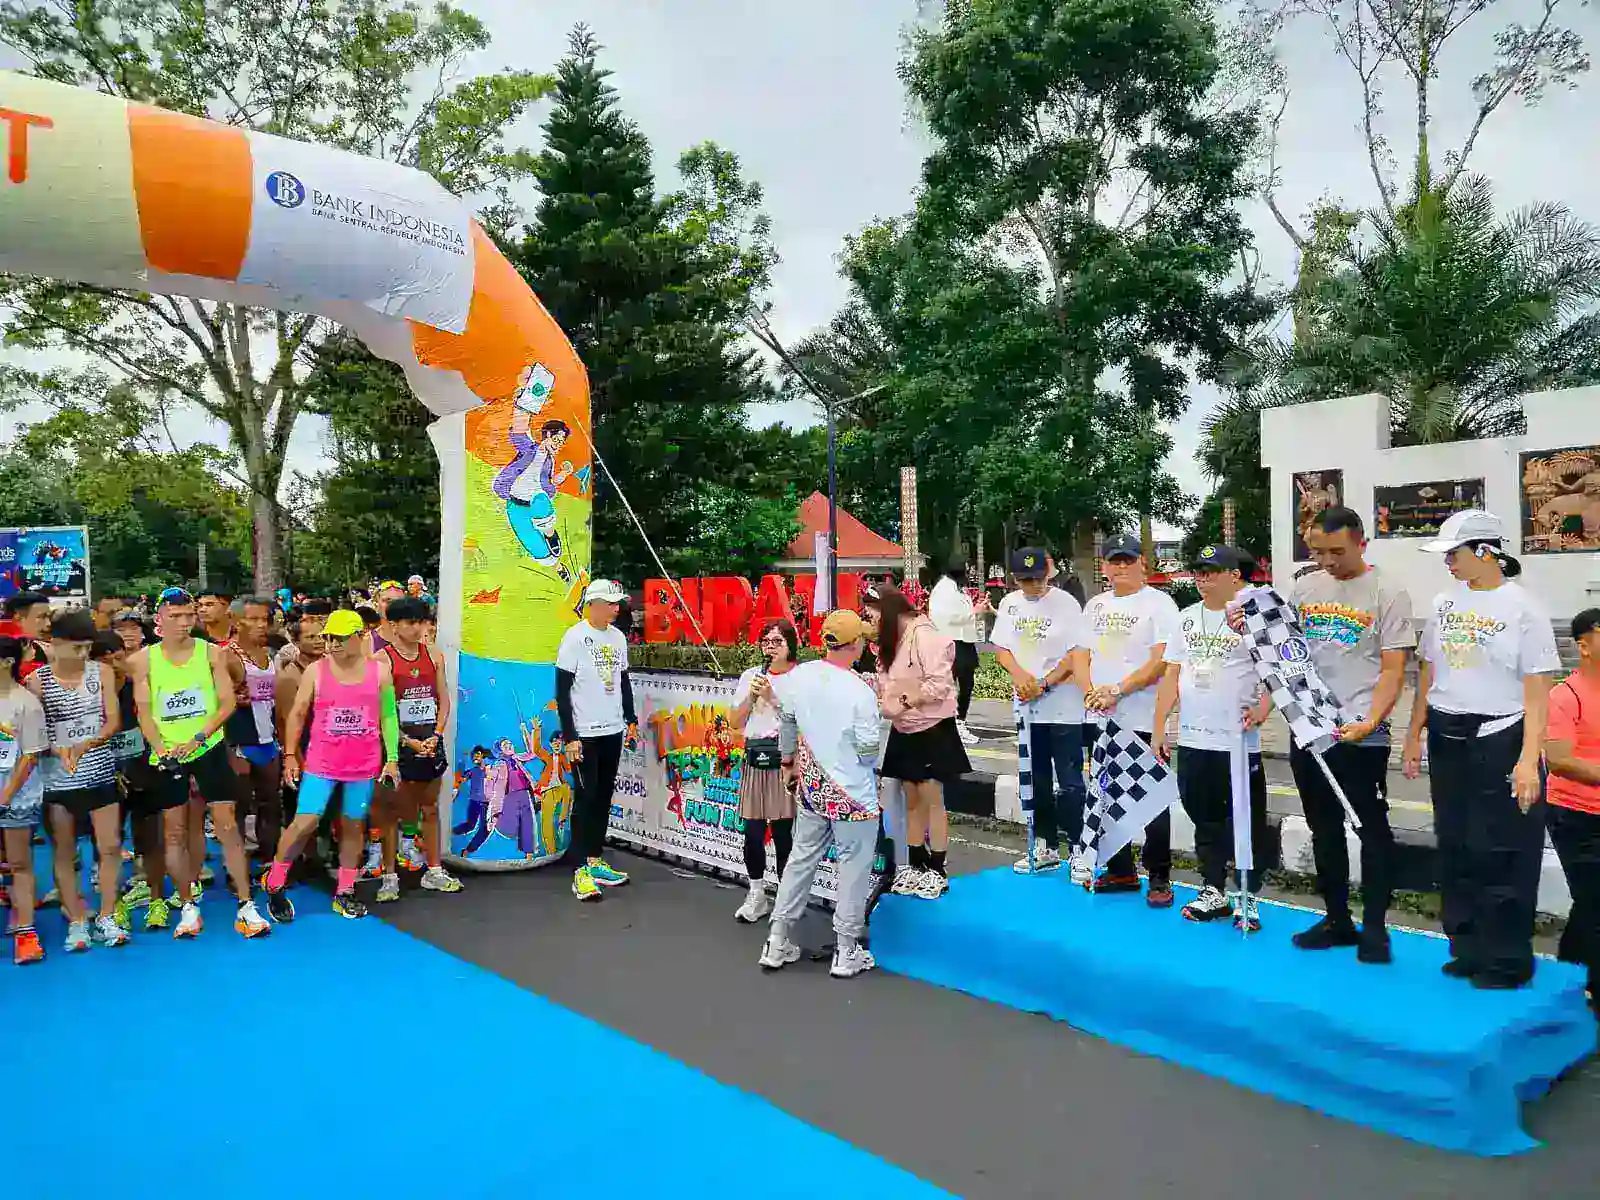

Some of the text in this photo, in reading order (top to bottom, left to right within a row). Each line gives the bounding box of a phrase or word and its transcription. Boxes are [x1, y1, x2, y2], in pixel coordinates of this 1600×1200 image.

[311, 188, 465, 247] BANK INDONESIA
[311, 208, 465, 256] BANK SENTRAL REPUBLIK INDONESIA
[165, 696, 196, 710] 0298
[685, 799, 746, 833] FUN RU
